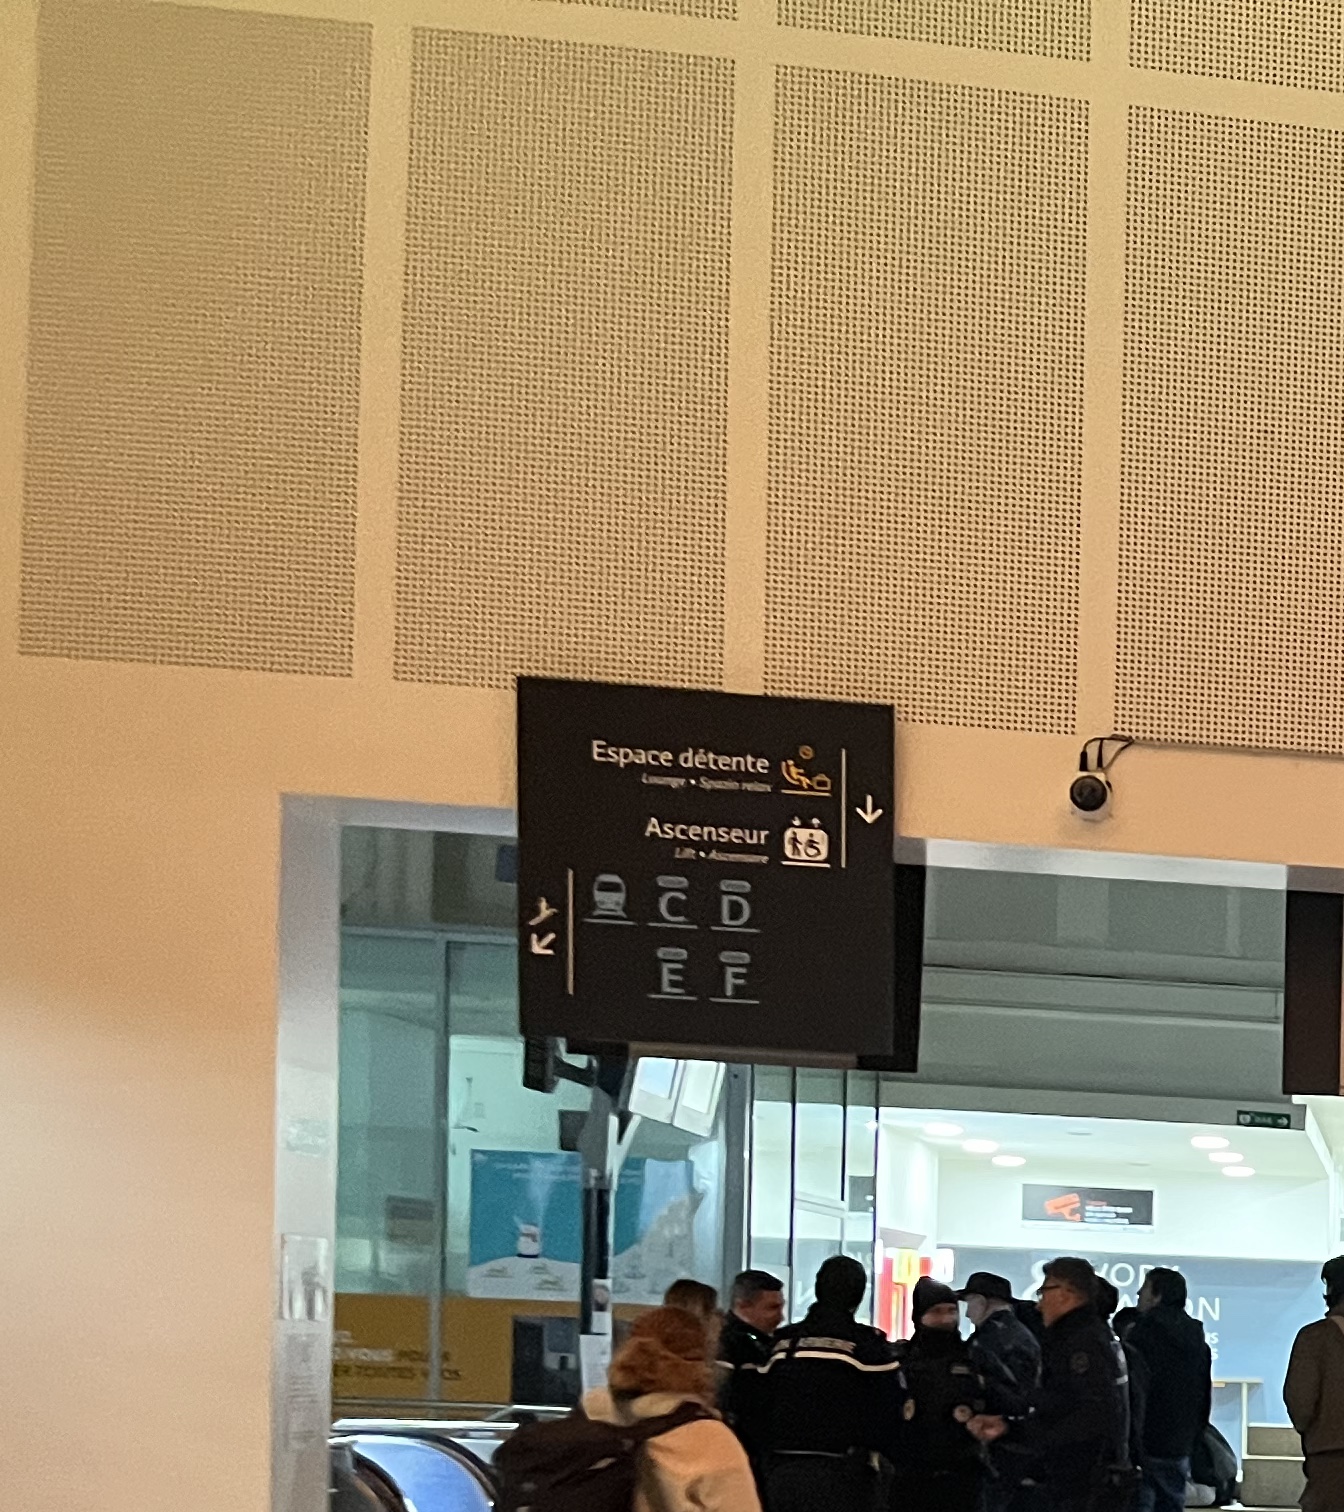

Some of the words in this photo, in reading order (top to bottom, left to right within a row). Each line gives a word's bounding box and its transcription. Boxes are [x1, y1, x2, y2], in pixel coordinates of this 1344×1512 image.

[592, 740, 674, 768] Espace
[679, 747, 770, 774] détente
[645, 817, 770, 845] Ascenseur
[659, 891, 688, 922] C
[721, 894, 751, 926] D
[661, 962, 685, 994] E
[725, 966, 747, 997] F
